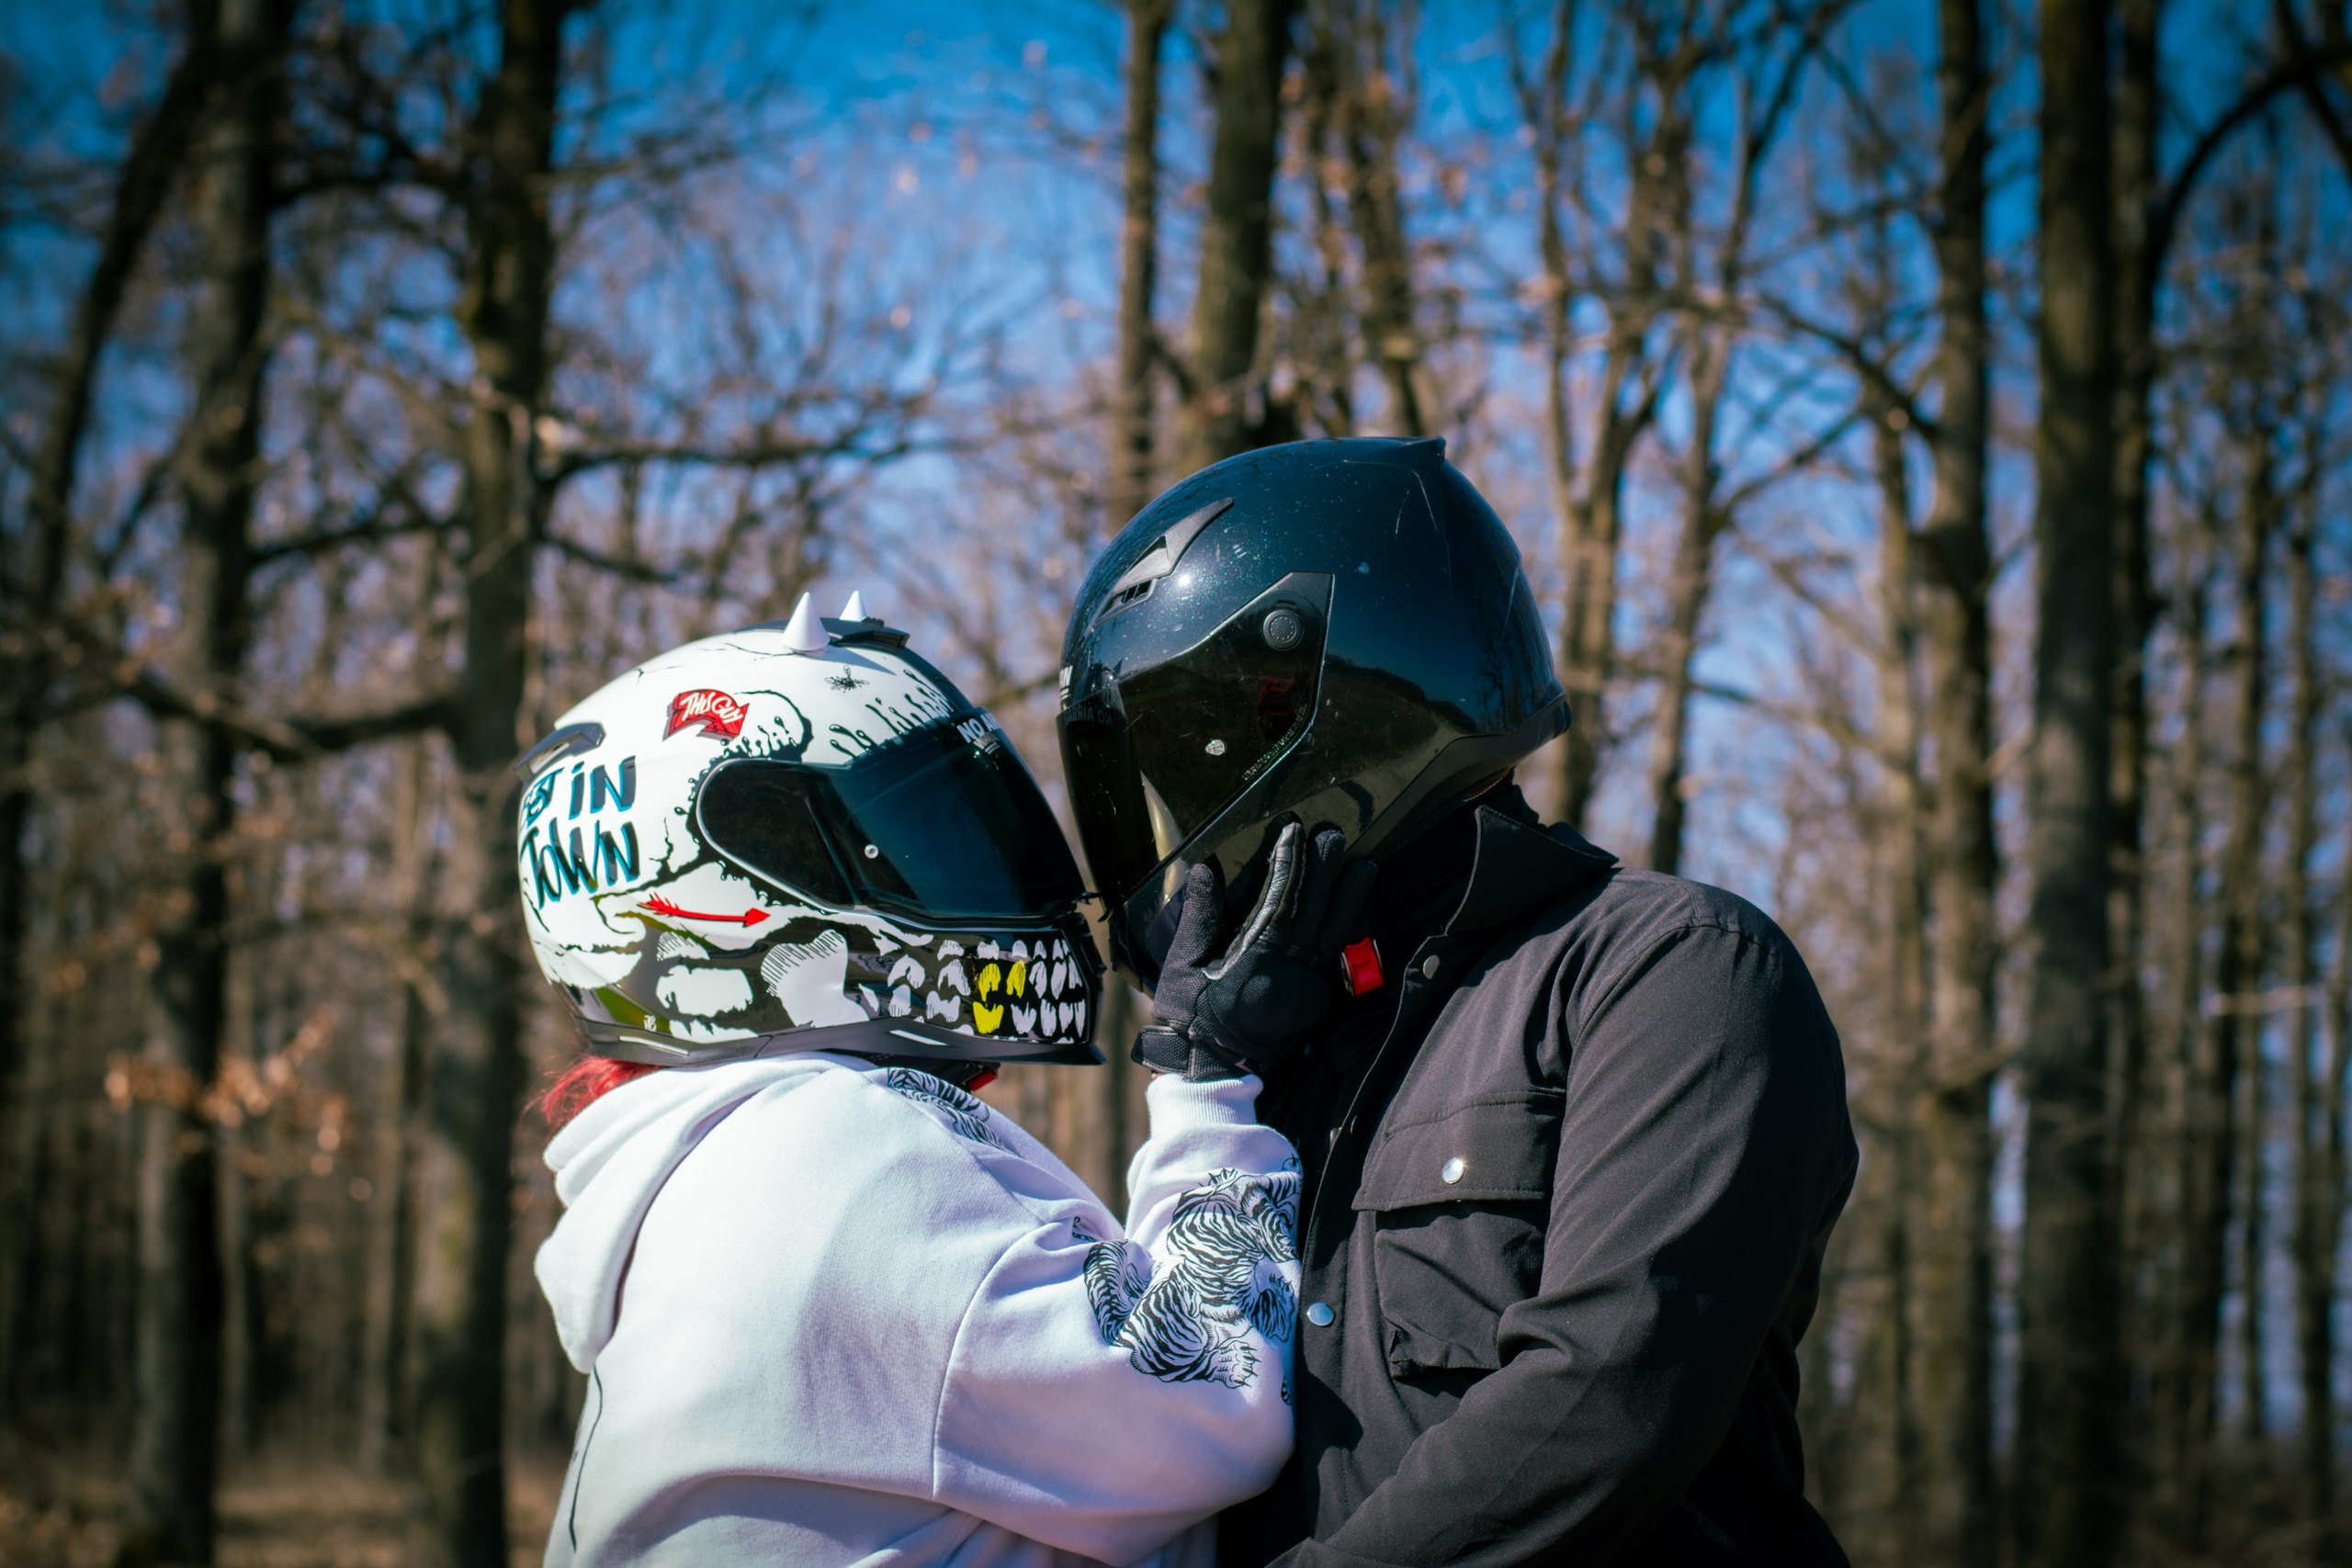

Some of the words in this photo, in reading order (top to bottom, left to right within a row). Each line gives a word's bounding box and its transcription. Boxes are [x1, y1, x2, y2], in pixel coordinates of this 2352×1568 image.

[680, 692, 717, 721] THIS
[711, 696, 743, 724] GUY
[956, 718, 986, 743] NO
[520, 817, 641, 910] TOWN
